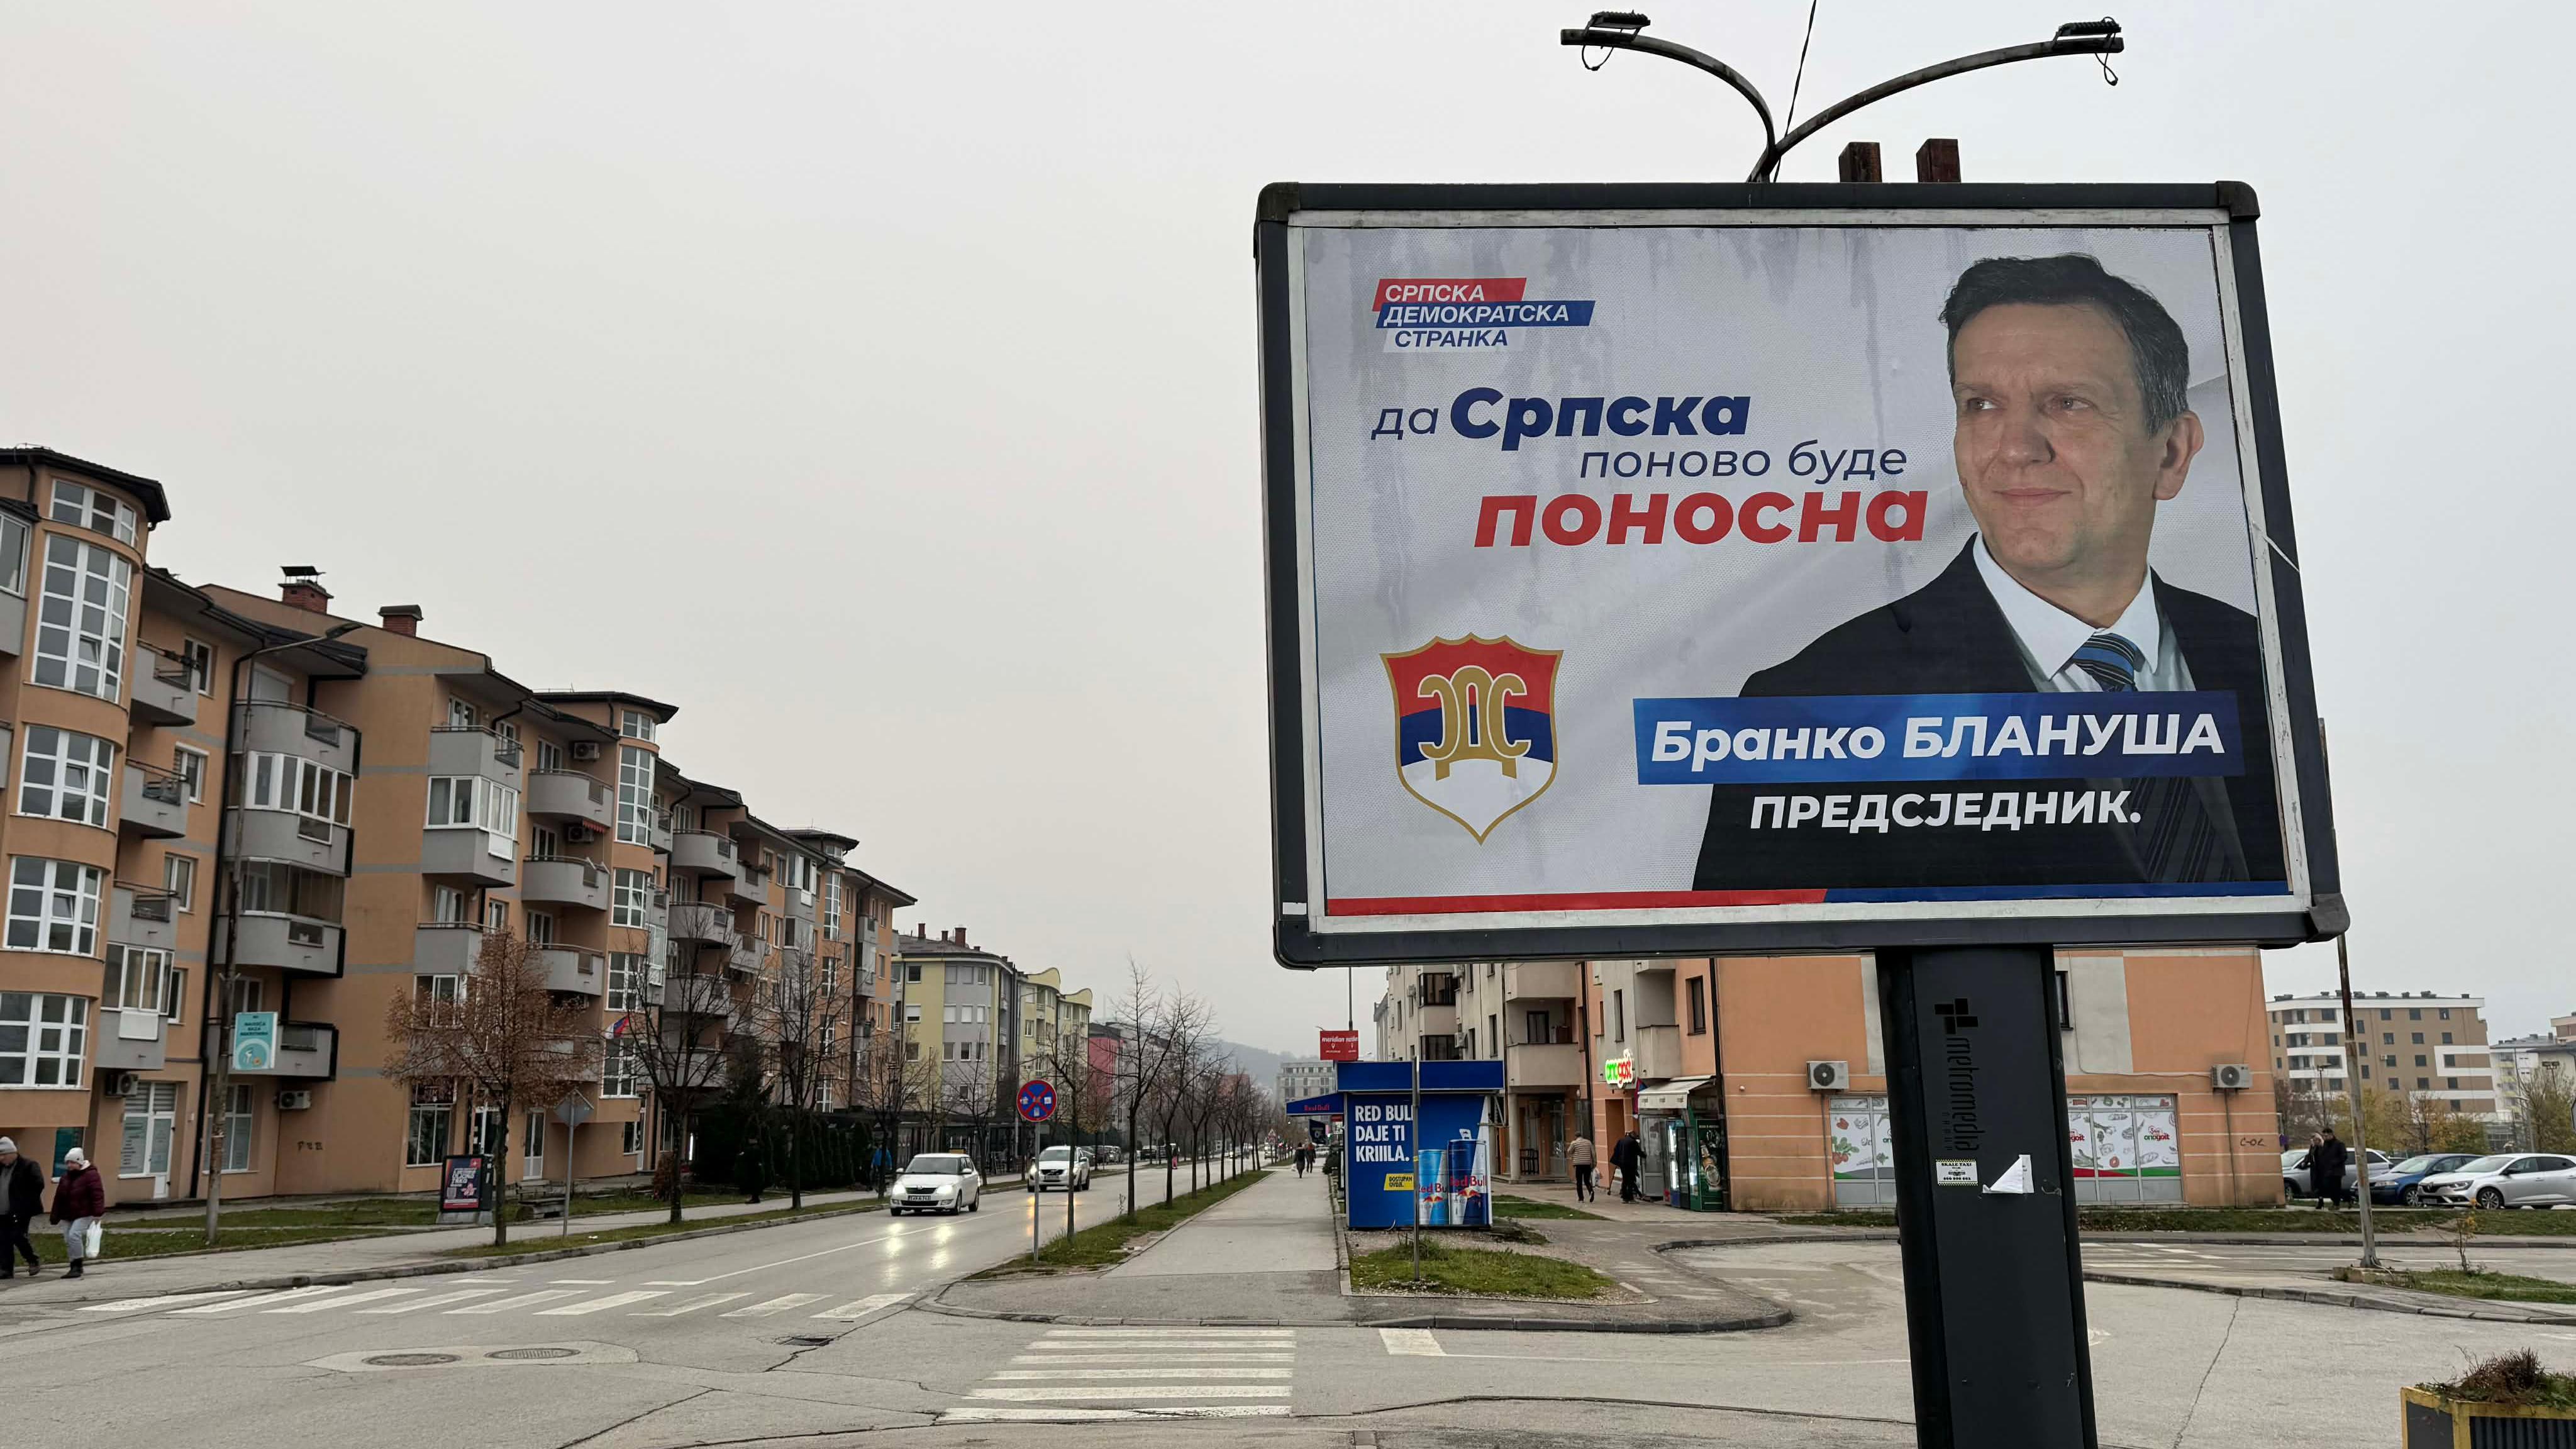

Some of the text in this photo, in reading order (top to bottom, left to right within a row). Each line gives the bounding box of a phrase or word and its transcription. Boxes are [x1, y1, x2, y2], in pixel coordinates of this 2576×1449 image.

[1385, 285, 1485, 302] СРПСКА
[1384, 305, 1569, 327] ДЕМОКРАТСКА
[1394, 330, 1507, 347] СТРАНКА
[1371, 387, 1750, 451] да Српска
[1580, 440, 1907, 484] поново буде
[1474, 491, 1928, 547] поносна
[1651, 713, 2225, 772] Бранко БЛАНУША
[1751, 791, 2141, 833] ПРЕДСЈЕДНИК.
[1946, 1038, 1985, 1151] metromedia
[1355, 1105, 1381, 1121] RED
[1355, 1125, 1405, 1141] DAJE TI
[1356, 1145, 1409, 1162] KRIIILA.
